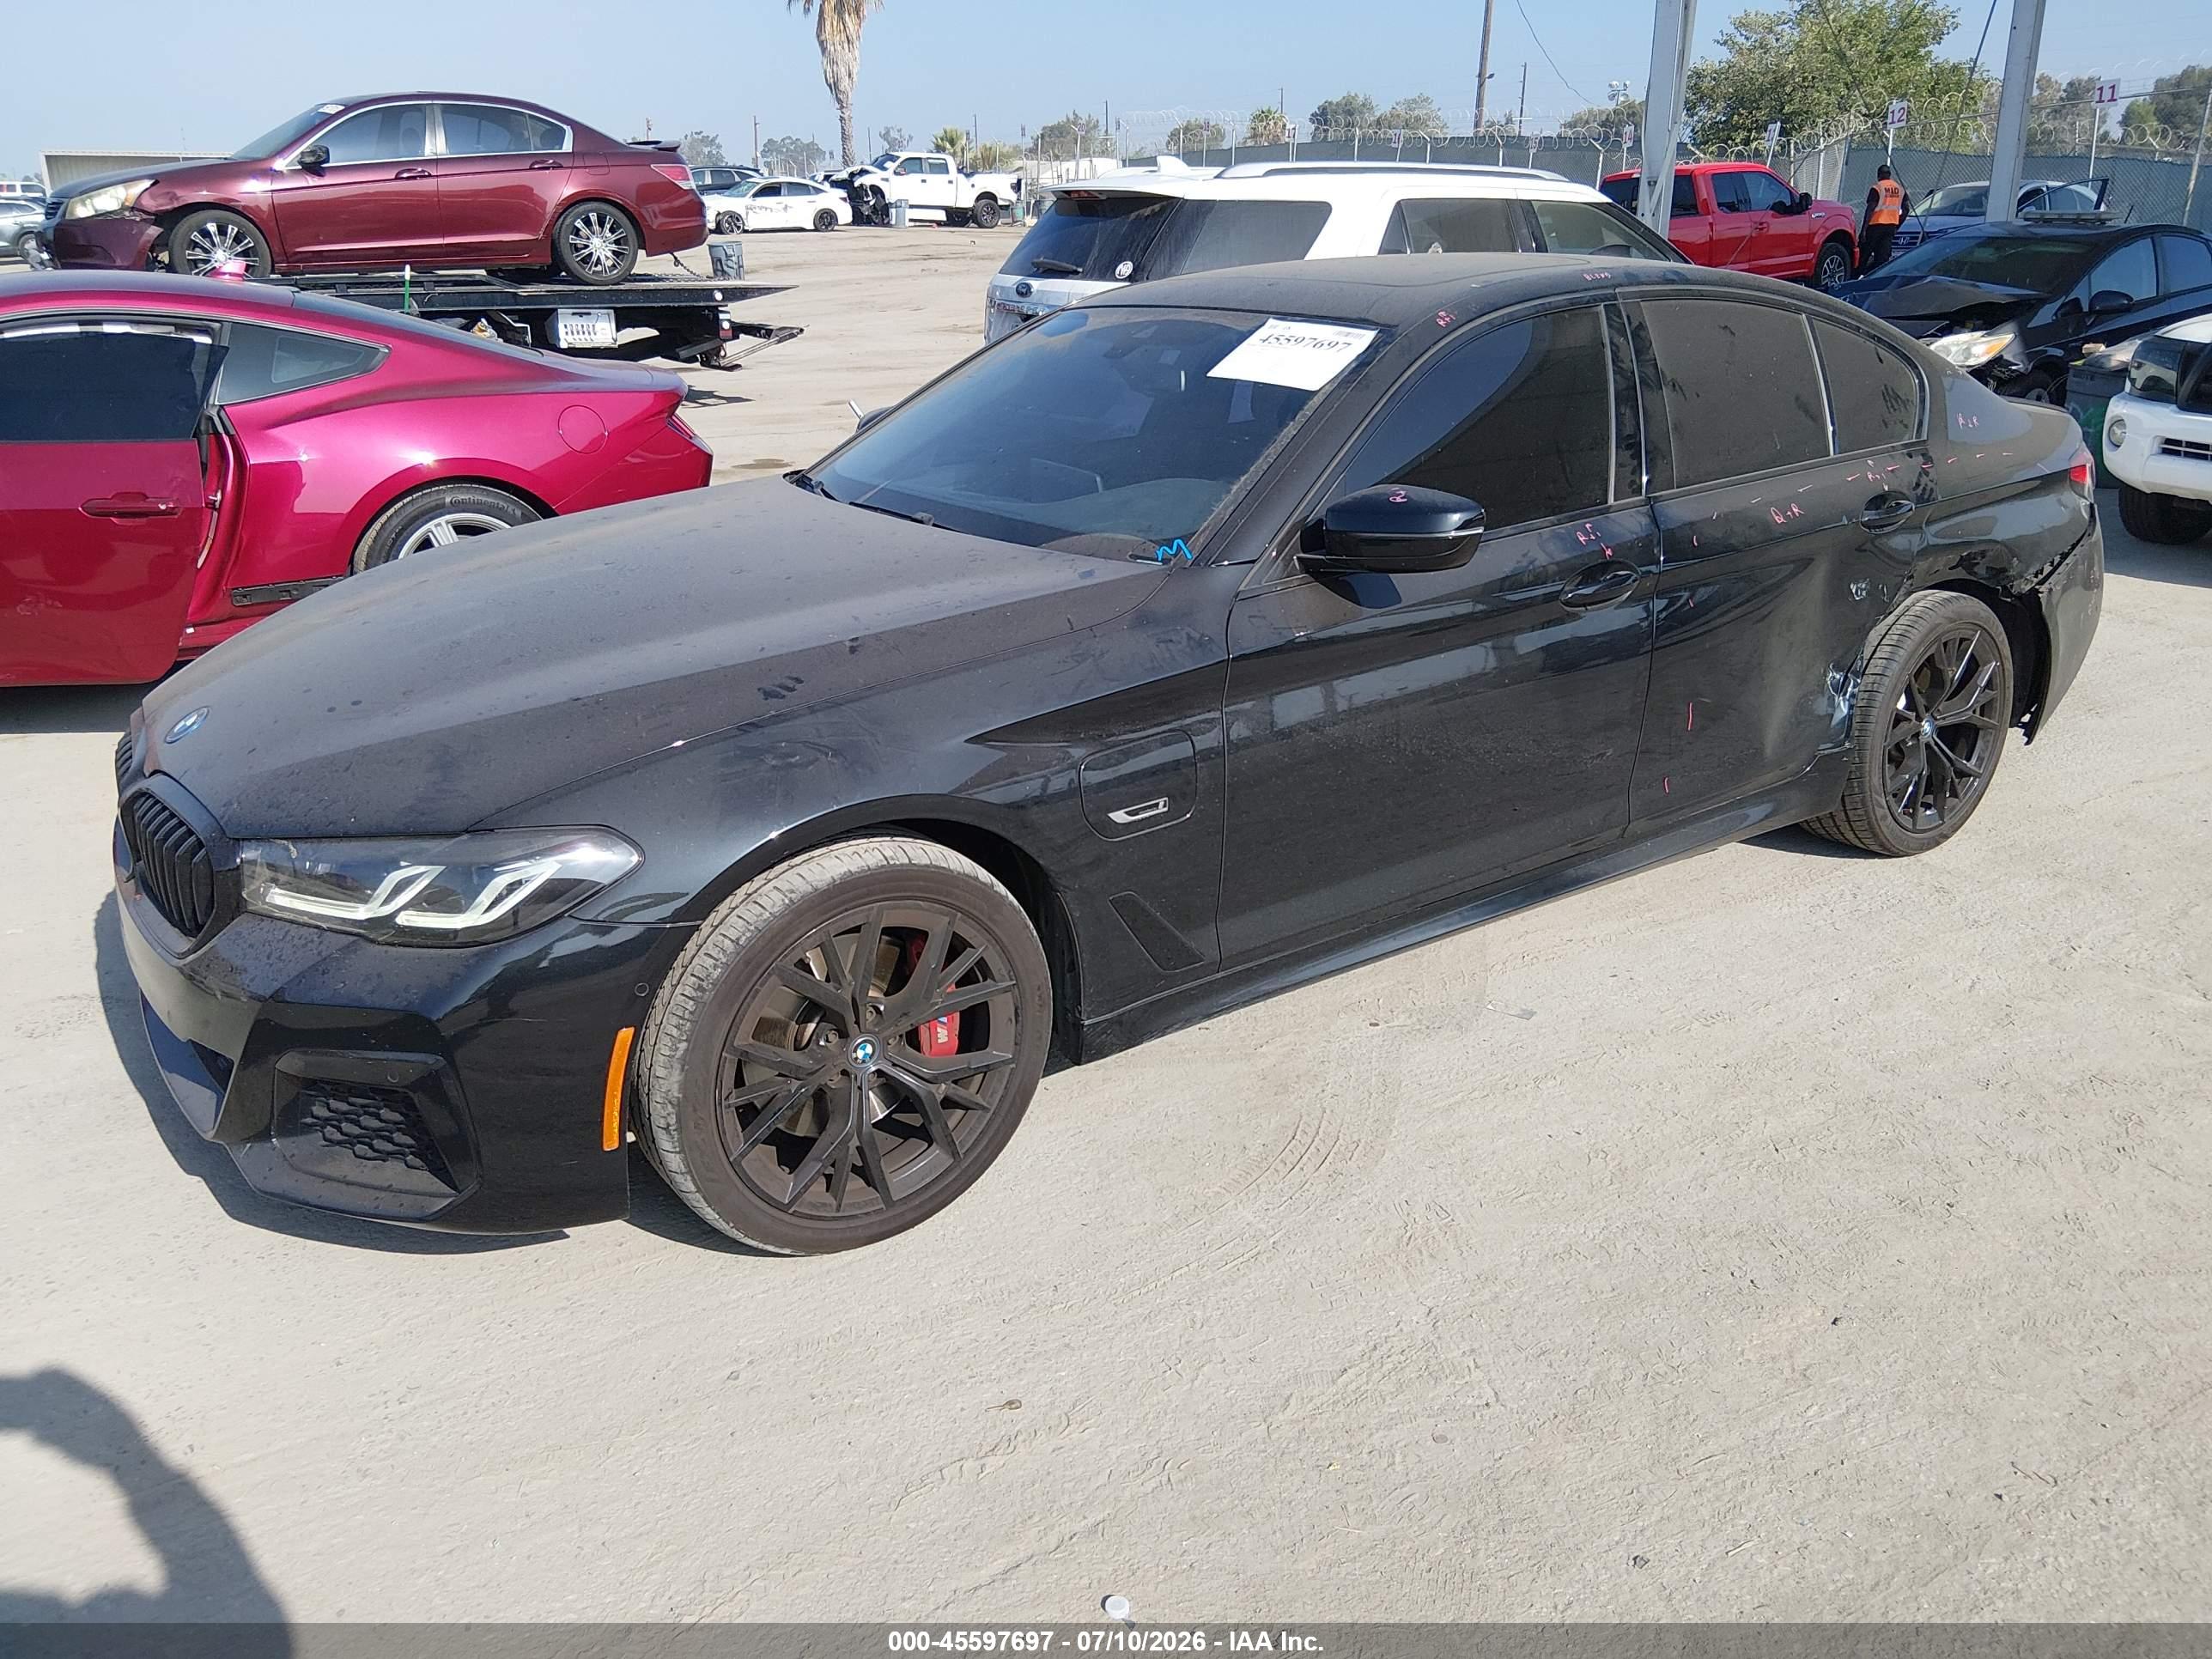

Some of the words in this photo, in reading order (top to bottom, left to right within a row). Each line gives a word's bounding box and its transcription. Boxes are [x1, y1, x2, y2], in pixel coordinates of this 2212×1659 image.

[2095, 84, 2118, 103] 11
[1888, 107, 1905, 125] 12
[1078, 122, 1085, 132] 20
[1259, 333, 1353, 353] 45597697
[449, 495, 509, 513] Continental
